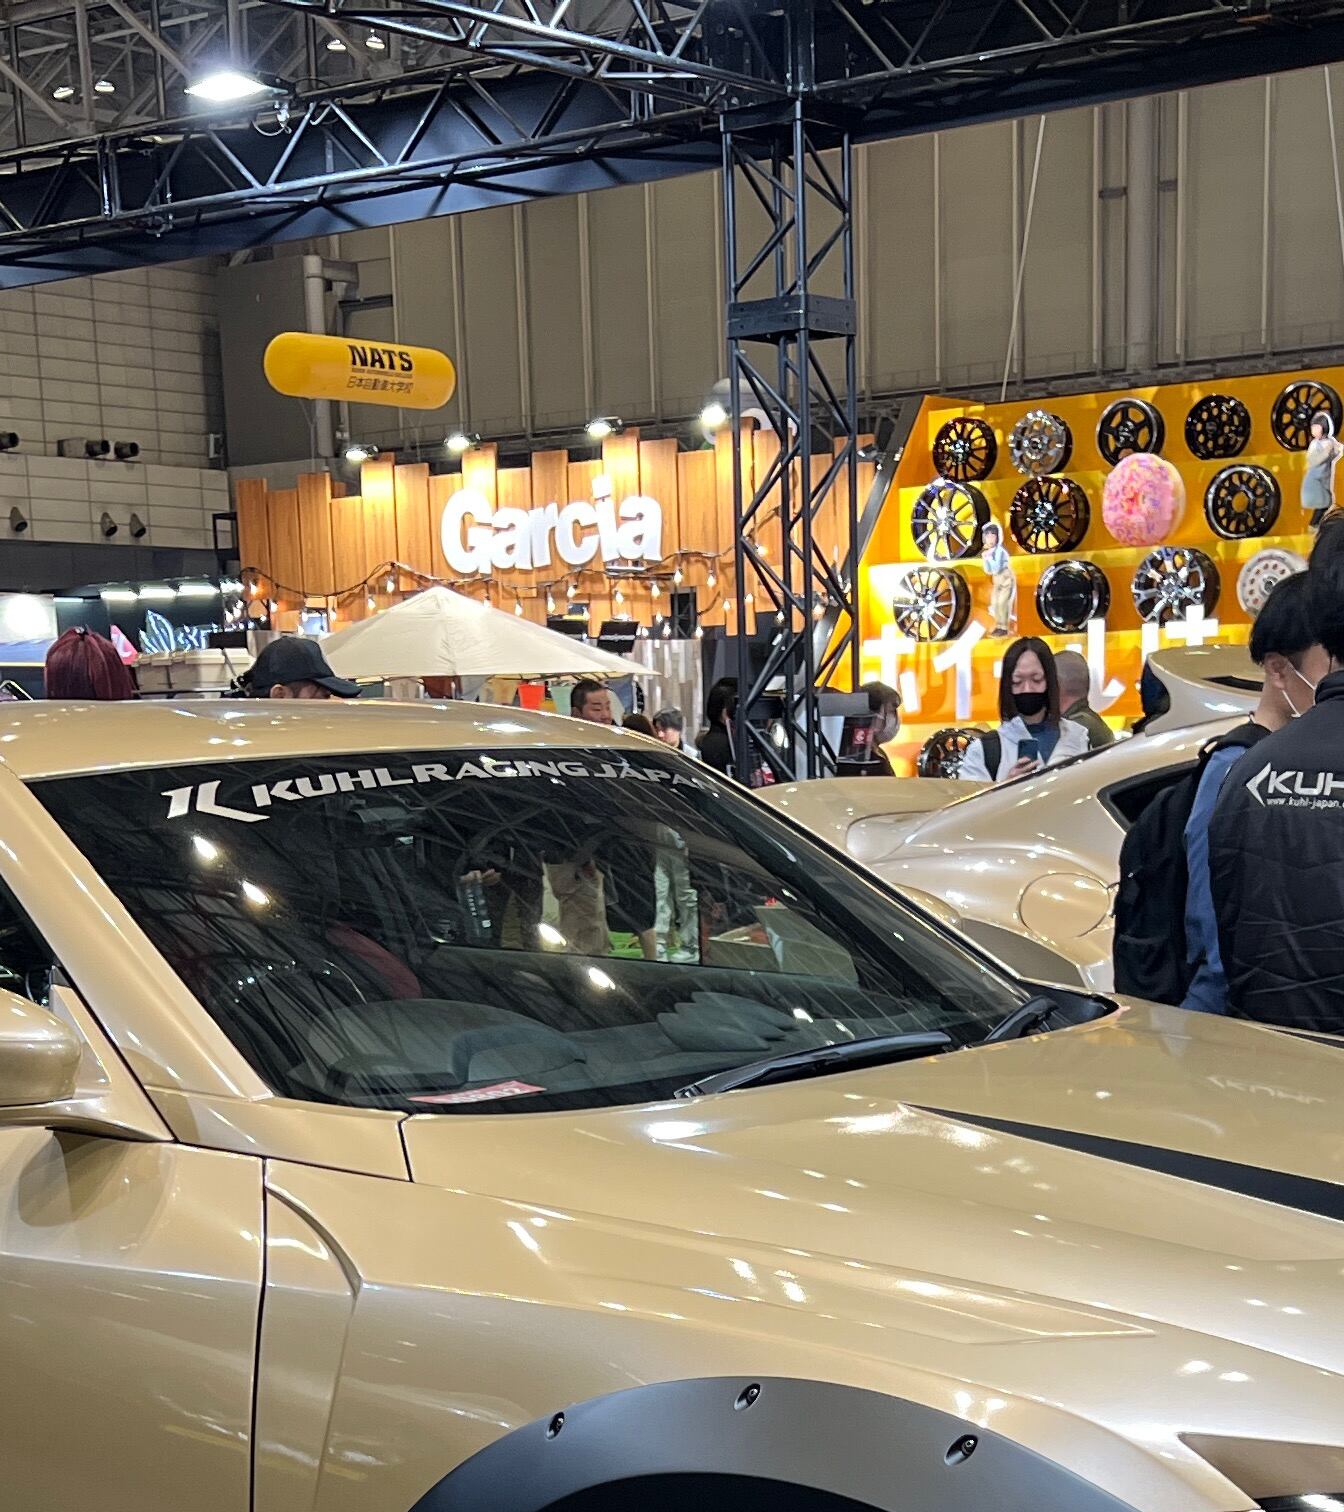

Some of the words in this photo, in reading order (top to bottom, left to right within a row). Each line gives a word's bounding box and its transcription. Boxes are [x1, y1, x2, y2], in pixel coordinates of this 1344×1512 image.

[347, 345, 414, 372] NATS
[441, 475, 662, 574] Garcia
[252, 767, 414, 807] KUHL
[411, 752, 590, 783] RACING
[594, 762, 720, 793] JAPAN
